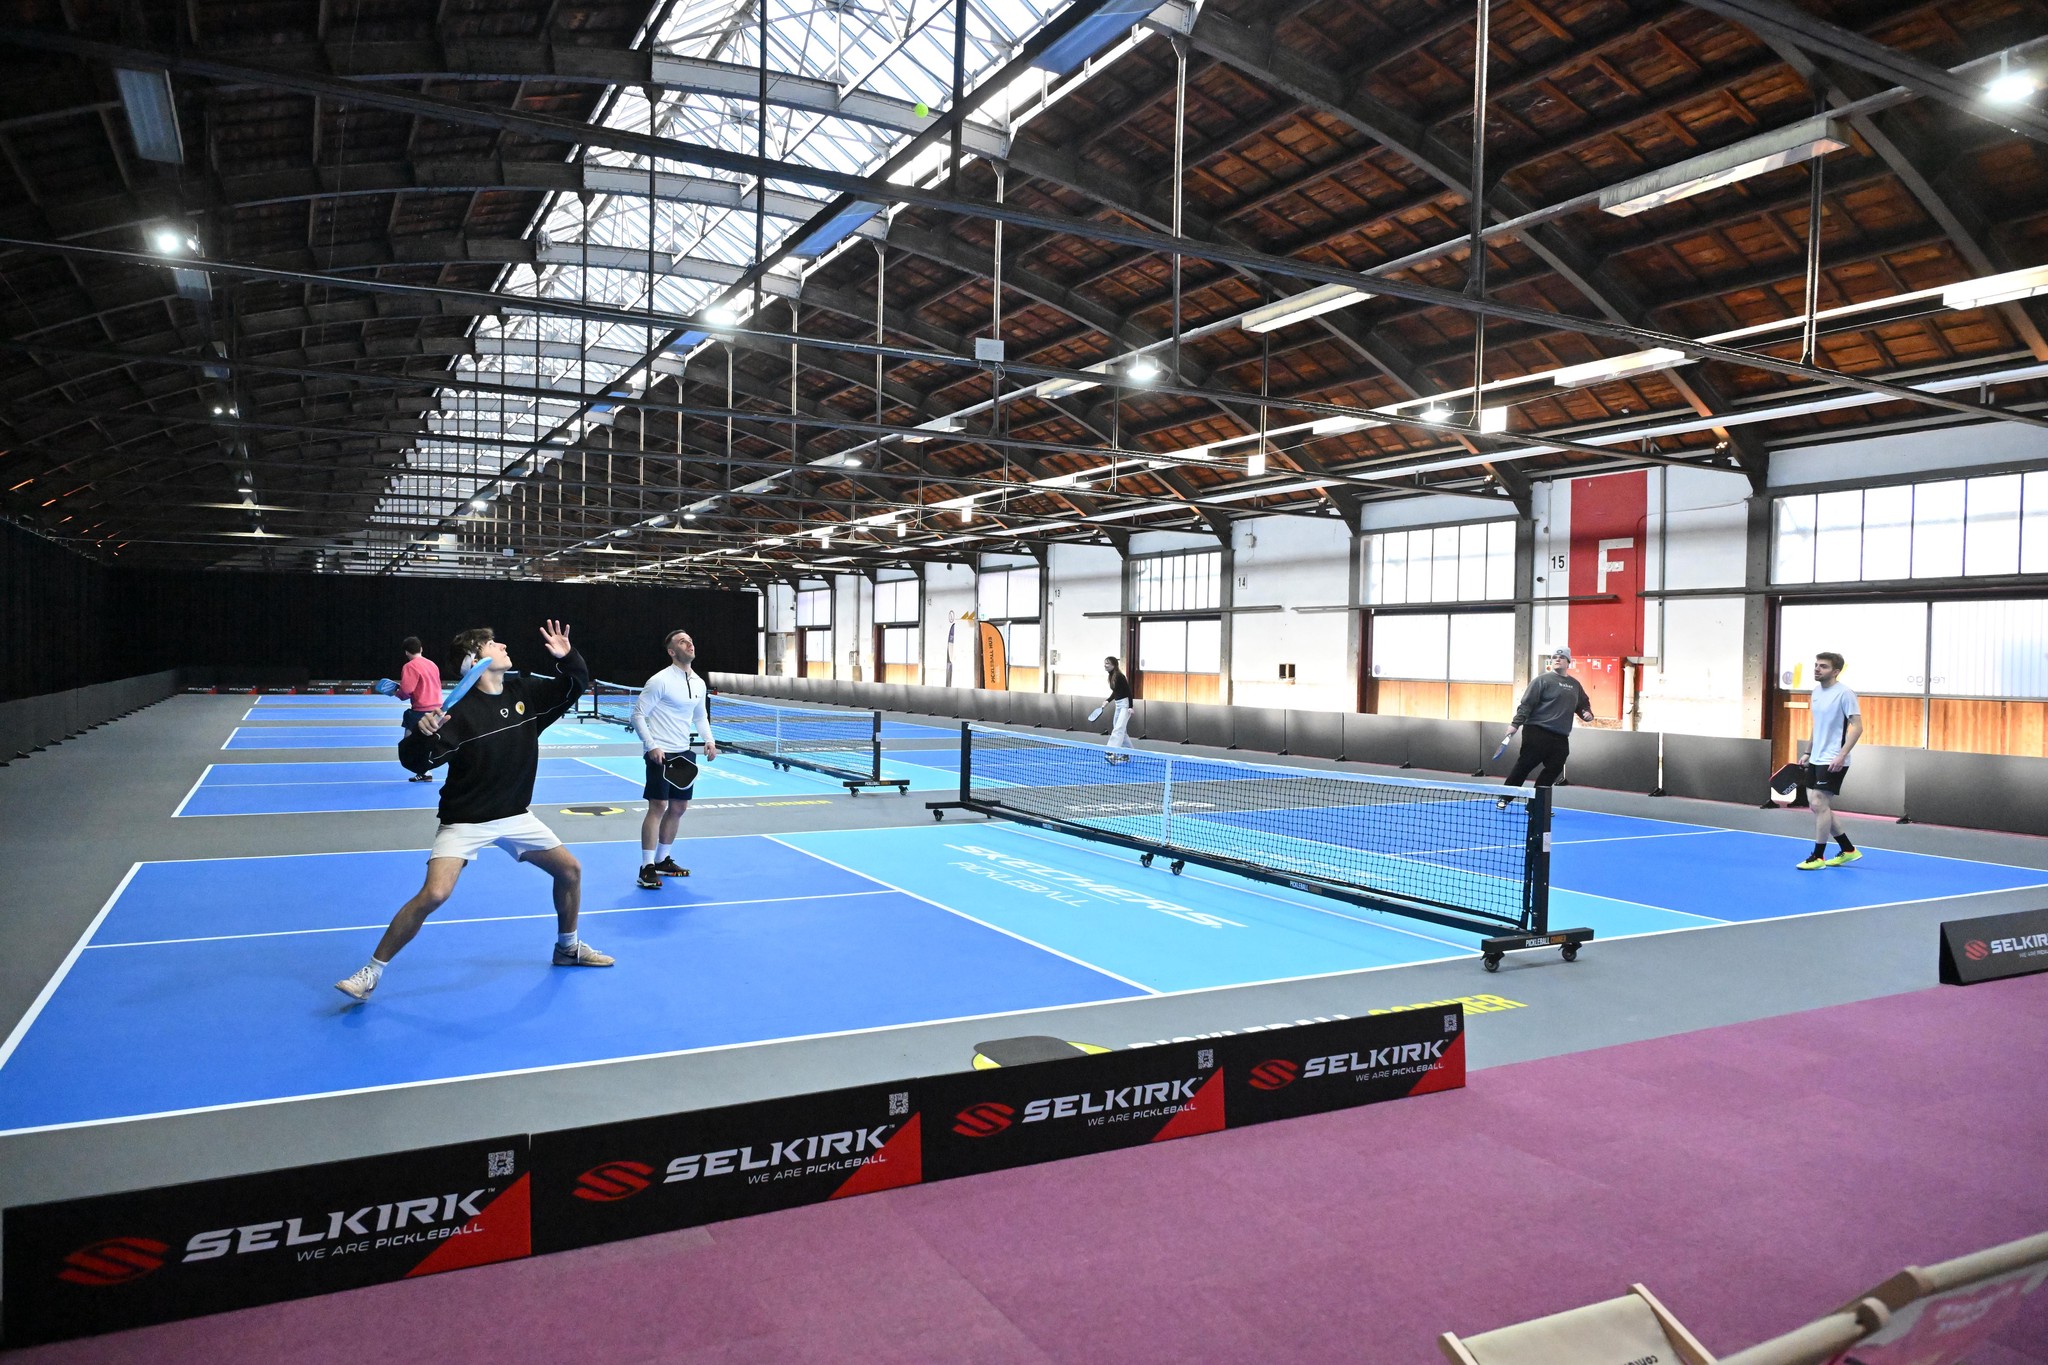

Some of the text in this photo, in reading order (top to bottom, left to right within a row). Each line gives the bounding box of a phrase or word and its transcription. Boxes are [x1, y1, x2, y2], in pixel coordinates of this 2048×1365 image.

[1551, 555, 1565, 569] 15
[1597, 537, 1634, 593] F
[1237, 577, 1246, 588] 14
[947, 861, 1089, 908] PICKLEBALL
[1525, 937, 1550, 948] PICKLEBALL
[1990, 933, 2048, 954] SELKIR
[1302, 1039, 1445, 1079] SELKIRK
[1355, 1062, 1445, 1082] WE ARE PICKLEBALL
[1021, 1077, 1198, 1124] SELKIRK
[1087, 1103, 1197, 1127] WE ARE PICKLEBALL
[662, 1124, 889, 1184] SELKIRK
[748, 1154, 887, 1185] WE ARE PICKLEBALL
[181, 1188, 486, 1263] SELKIRK
[296, 1223, 485, 1262] WE ARE PICKLEBALL
